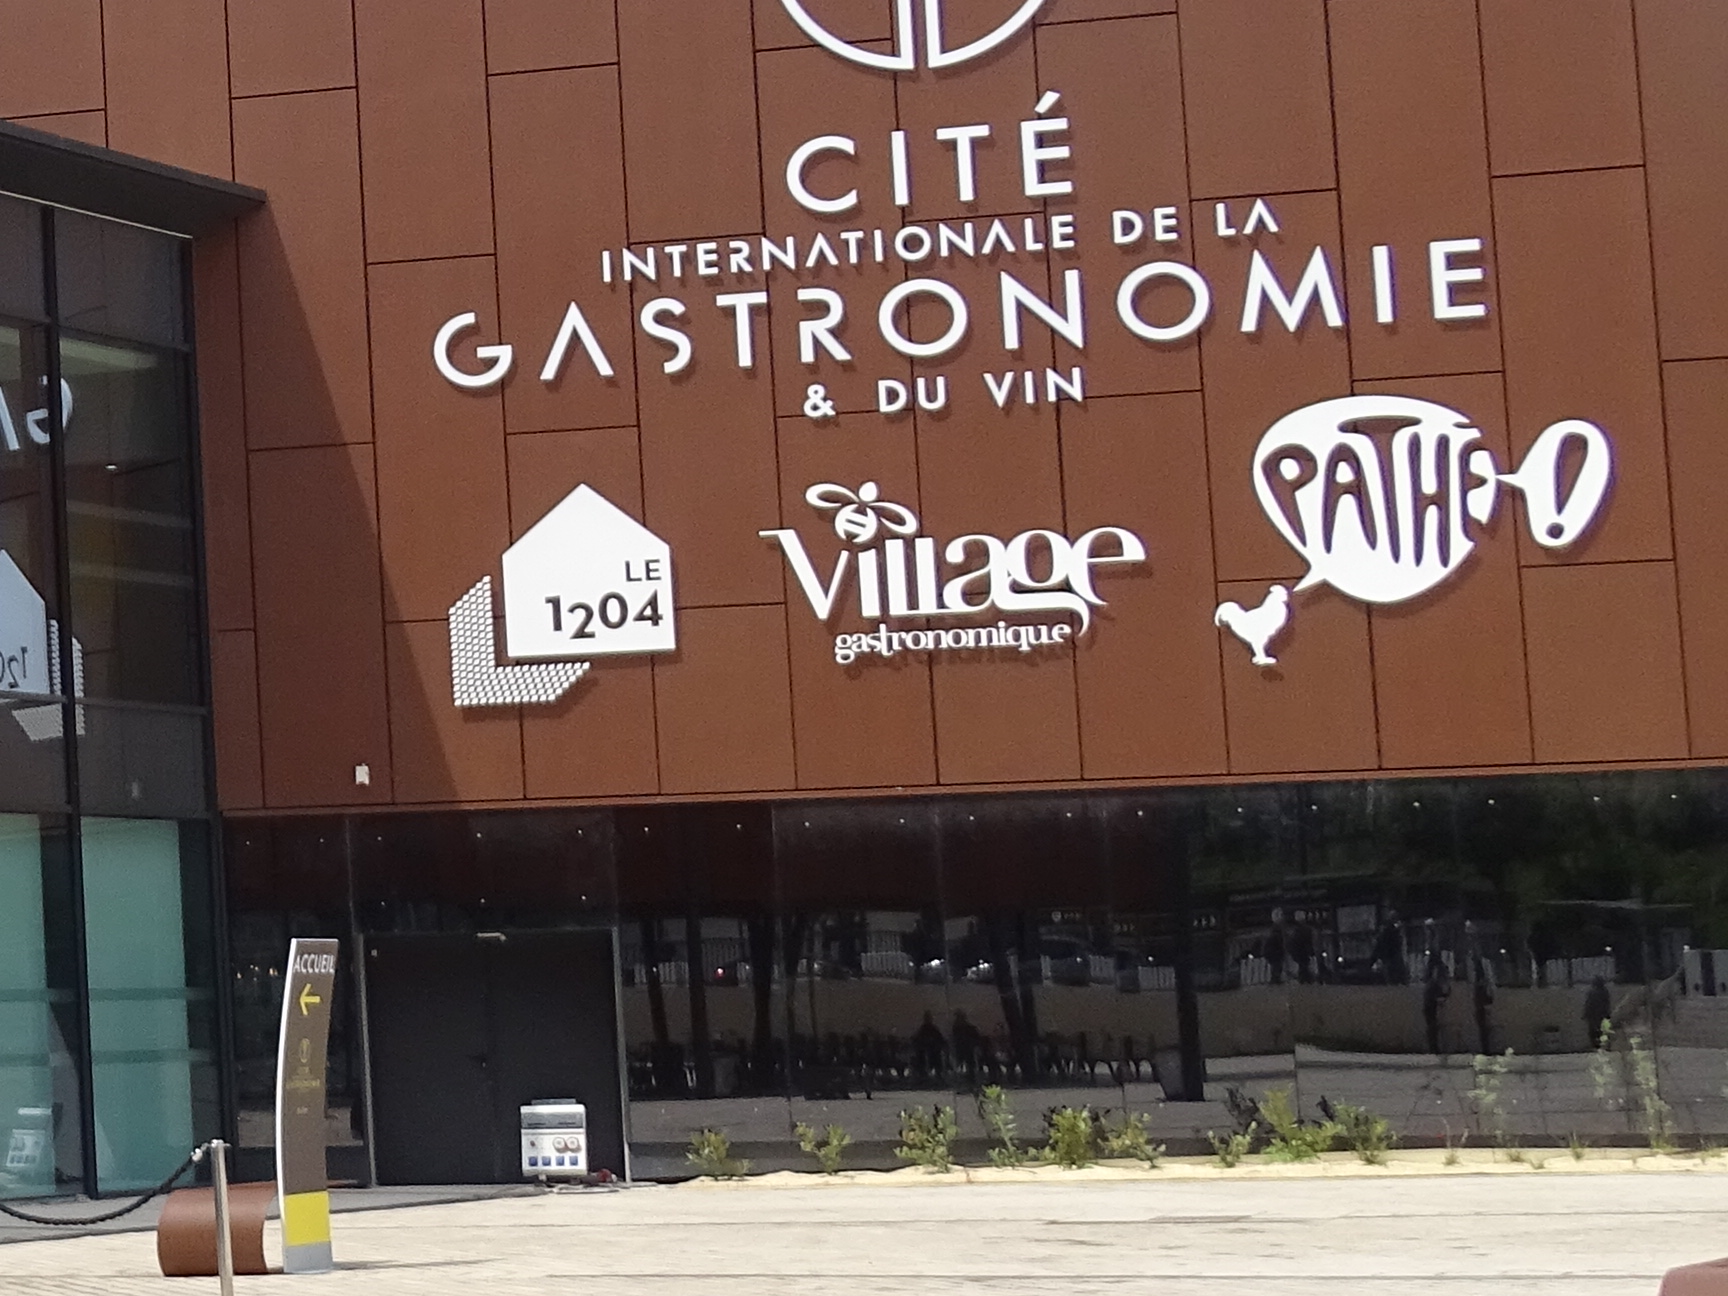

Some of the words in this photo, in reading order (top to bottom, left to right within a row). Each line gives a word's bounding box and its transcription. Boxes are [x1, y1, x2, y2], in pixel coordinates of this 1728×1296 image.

[786, 91, 1073, 213] CITÉ
[601, 214, 1075, 283] INTERNATIONALE
[1113, 206, 1178, 244] DE
[1216, 198, 1279, 237] LA
[433, 238, 1487, 388] GASTRONOMIE
[804, 383, 836, 417] &
[878, 376, 945, 412] DU
[983, 367, 1084, 408] VIN
[626, 559, 662, 582] LE
[759, 526, 1146, 637] Village
[544, 592, 664, 639] 1204
[835, 621, 1071, 664] gastronomique
[294, 954, 336, 973] ACCUEIL
